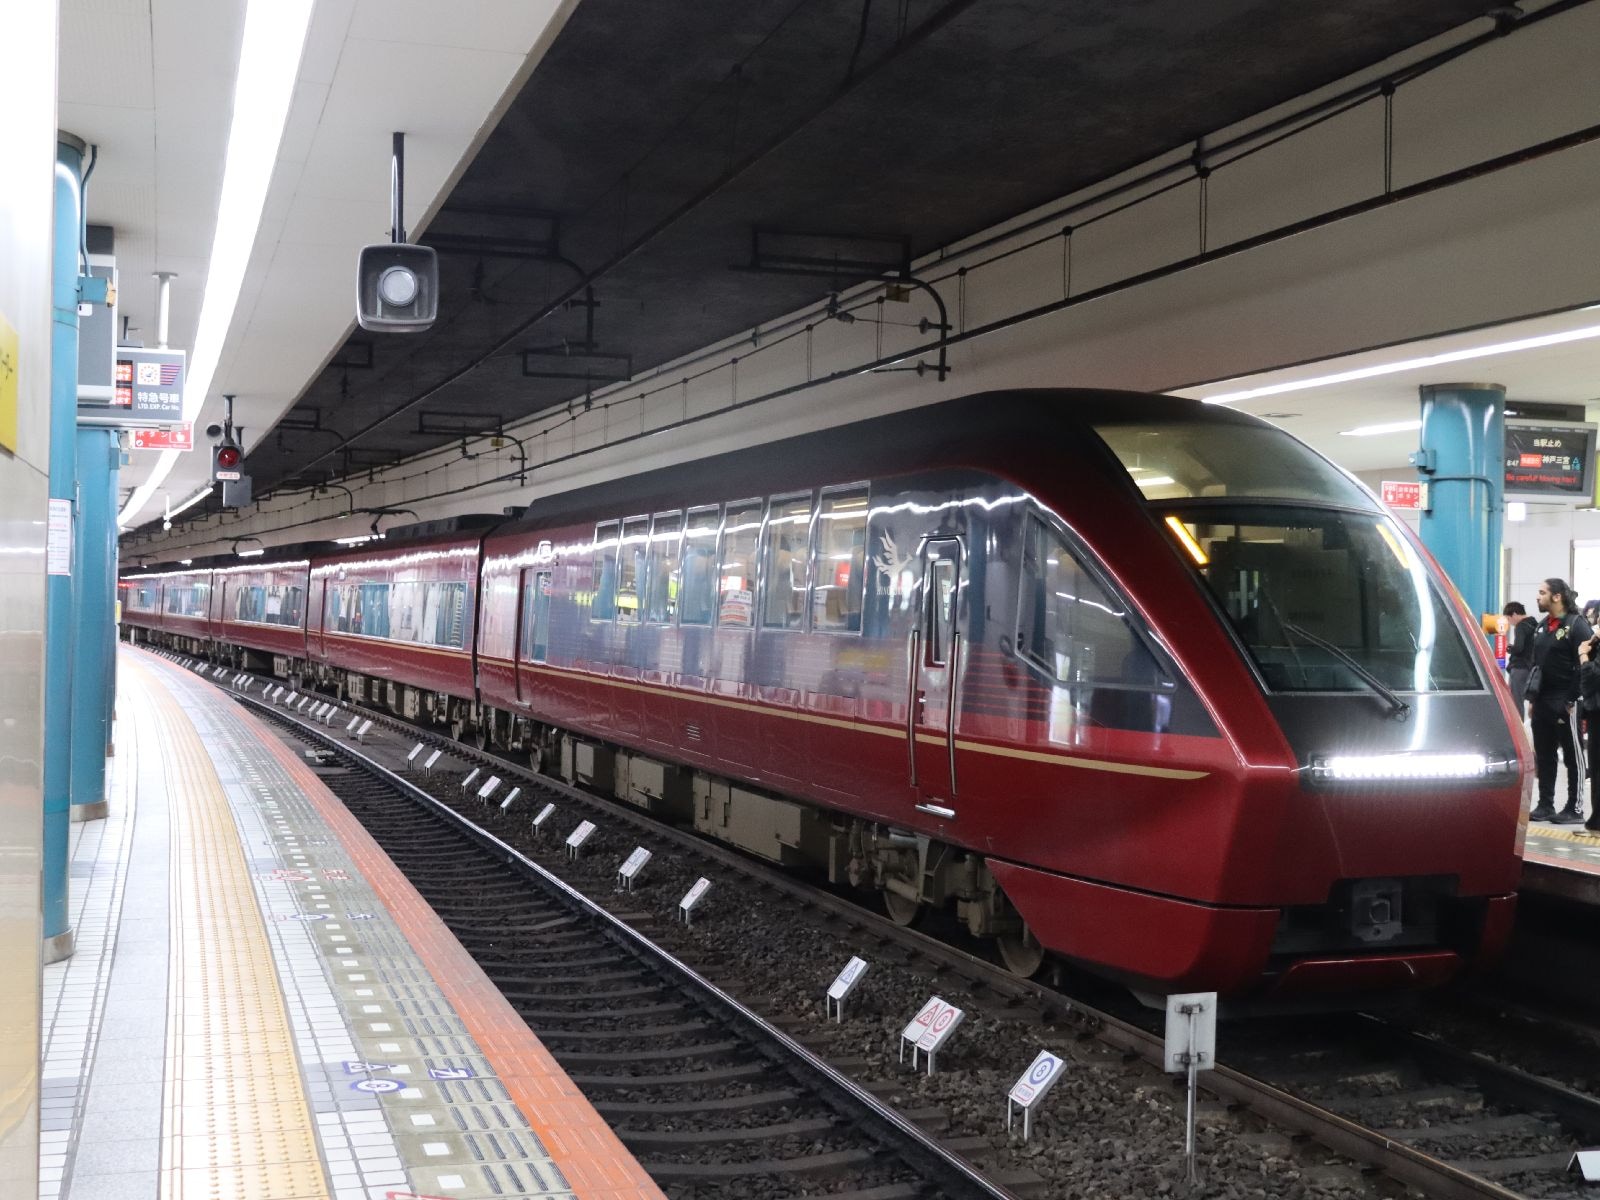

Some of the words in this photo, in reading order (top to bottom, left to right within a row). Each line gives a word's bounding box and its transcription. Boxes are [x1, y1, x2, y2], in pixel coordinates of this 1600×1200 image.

[137, 392, 180, 403] 特急号車
[1533, 438, 1562, 448] 当駅止め
[1542, 454, 1570, 464] 神戸三宮
[1036, 1064, 1048, 1077] 8
